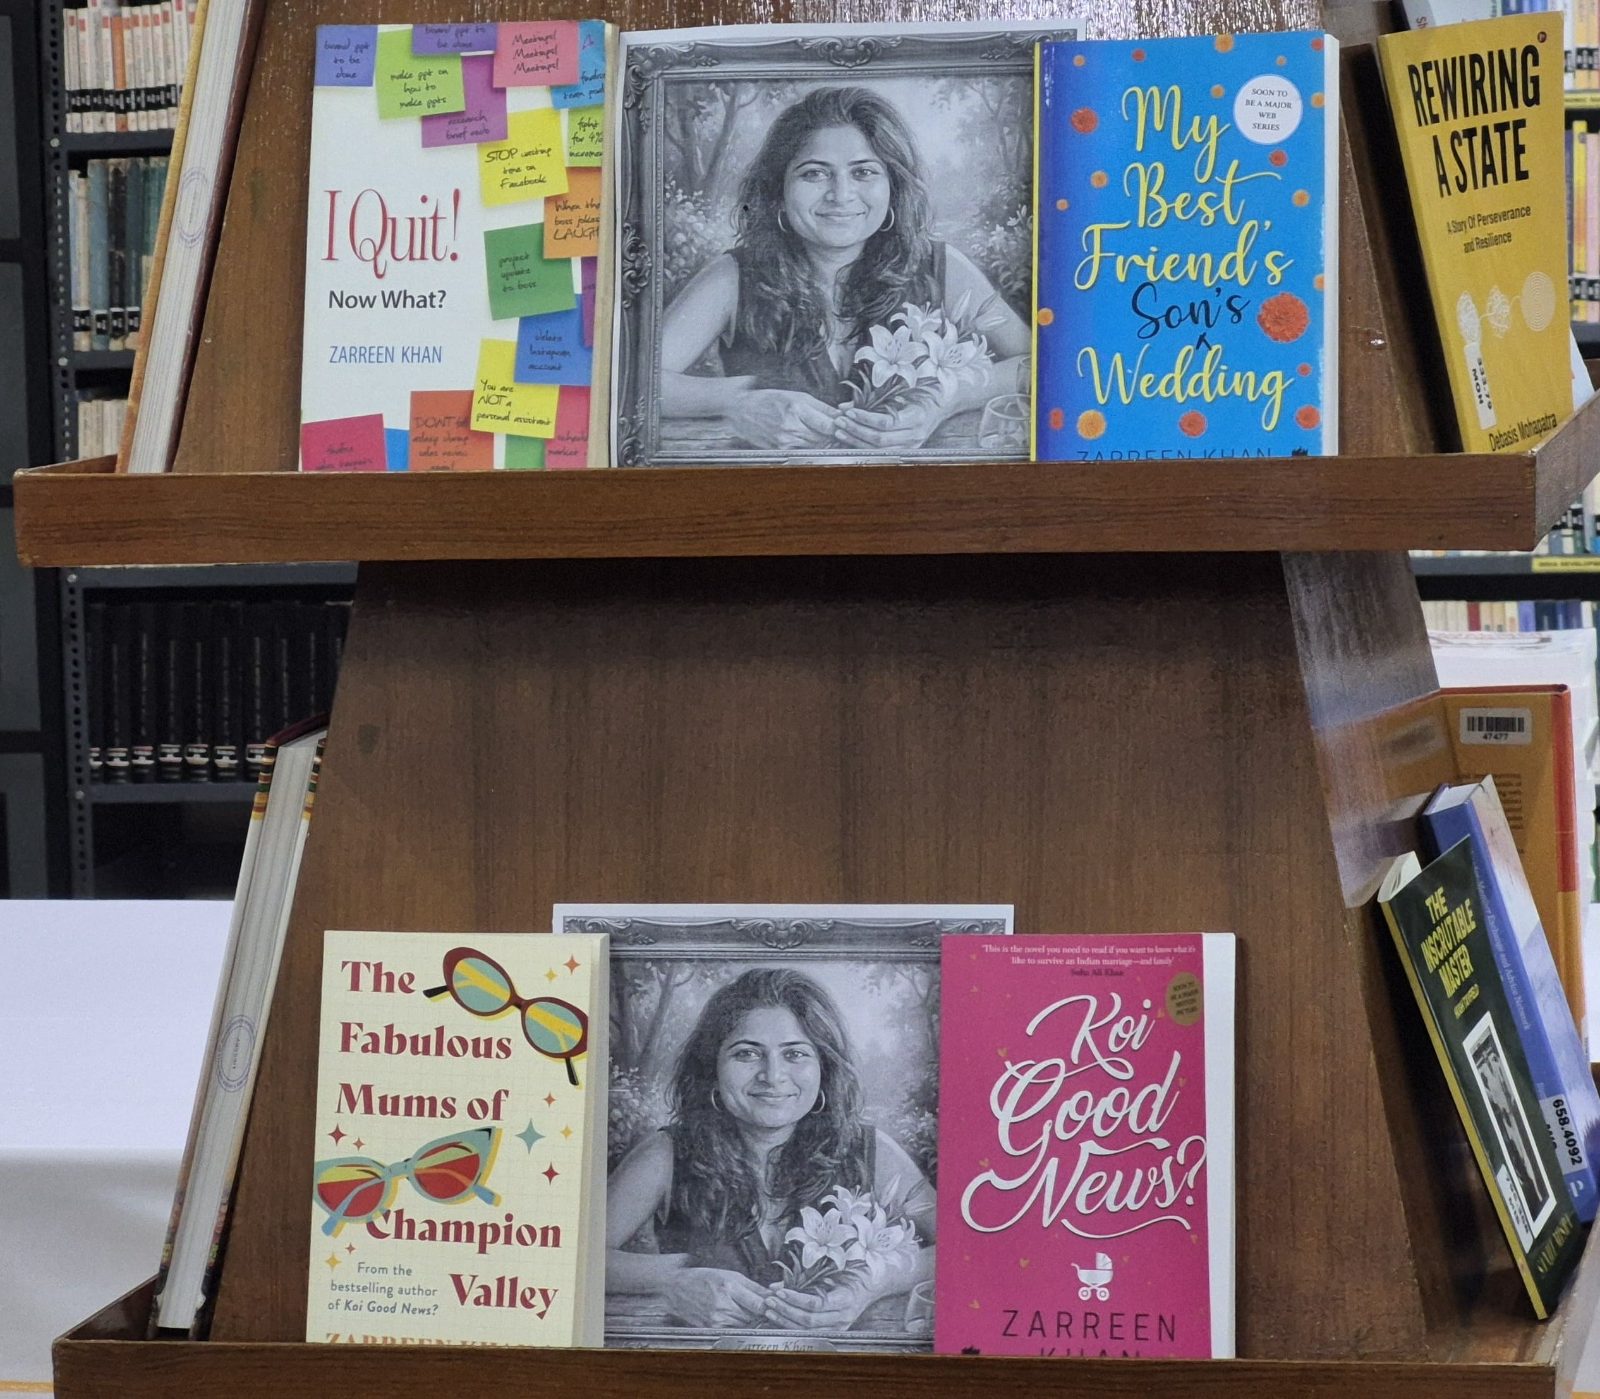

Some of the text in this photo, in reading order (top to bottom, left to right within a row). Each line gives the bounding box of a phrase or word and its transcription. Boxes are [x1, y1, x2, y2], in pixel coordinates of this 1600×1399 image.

[1251, 88, 1275, 96] SOON
[1407, 44, 1541, 127] REWIRING
[1245, 99, 1256, 107] BE
[1264, 101, 1292, 109] MAJOR
[1121, 84, 1231, 184] My
[1251, 122, 1280, 131] SERIES
[484, 147, 518, 163] STOP
[1432, 118, 1529, 198] A STATE
[500, 174, 547, 189] Facebook
[1123, 159, 1282, 228] Best
[321, 188, 461, 279] I Quit!
[554, 216, 573, 226] boss
[1452, 219, 1468, 234] Story
[1476, 205, 1532, 228] Perseverance
[1074, 220, 1294, 290] Friend's
[1463, 231, 1513, 254] and Resilience
[329, 290, 447, 309] Now What?
[1131, 281, 1251, 339] Son's
[329, 346, 442, 364] ZARREEN KHAN
[477, 394, 507, 406] NOT
[480, 379, 497, 392] You
[1077, 343, 1295, 431] Wedding
[476, 411, 511, 422] personal
[1488, 412, 1558, 451] Debasis Mohapatra
[1425, 886, 1448, 924] THE
[1010, 945, 1022, 953] the
[1024, 945, 1046, 954] novel
[1046, 947, 1061, 956] you
[1062, 945, 1081, 954] need
[1091, 945, 1108, 954] read
[1109, 945, 1115, 954] if
[1115, 947, 1129, 956] you
[1420, 898, 1477, 974] INSCRUTABLE
[340, 960, 416, 994] The
[1011, 956, 1026, 965] like
[1027, 957, 1036, 965] to
[1037, 957, 1065, 965] survive
[1076, 956, 1101, 965] Indian
[1438, 943, 1474, 999] MASTER
[339, 1022, 512, 1060] Fabulous
[1026, 992, 1157, 1080] Koi
[335, 1083, 510, 1121] Mums of
[990, 1050, 1182, 1190] Good
[1552, 1098, 1583, 1166] 658.4092
[961, 1135, 1207, 1231] News?
[366, 1208, 562, 1255] Champion
[357, 1262, 413, 1277] From the
[330, 1280, 438, 1299] bestselling author
[449, 1273, 559, 1320] Valley
[327, 1300, 439, 1316] of Koi Good News?
[1002, 1310, 1176, 1343] ZARREEN
